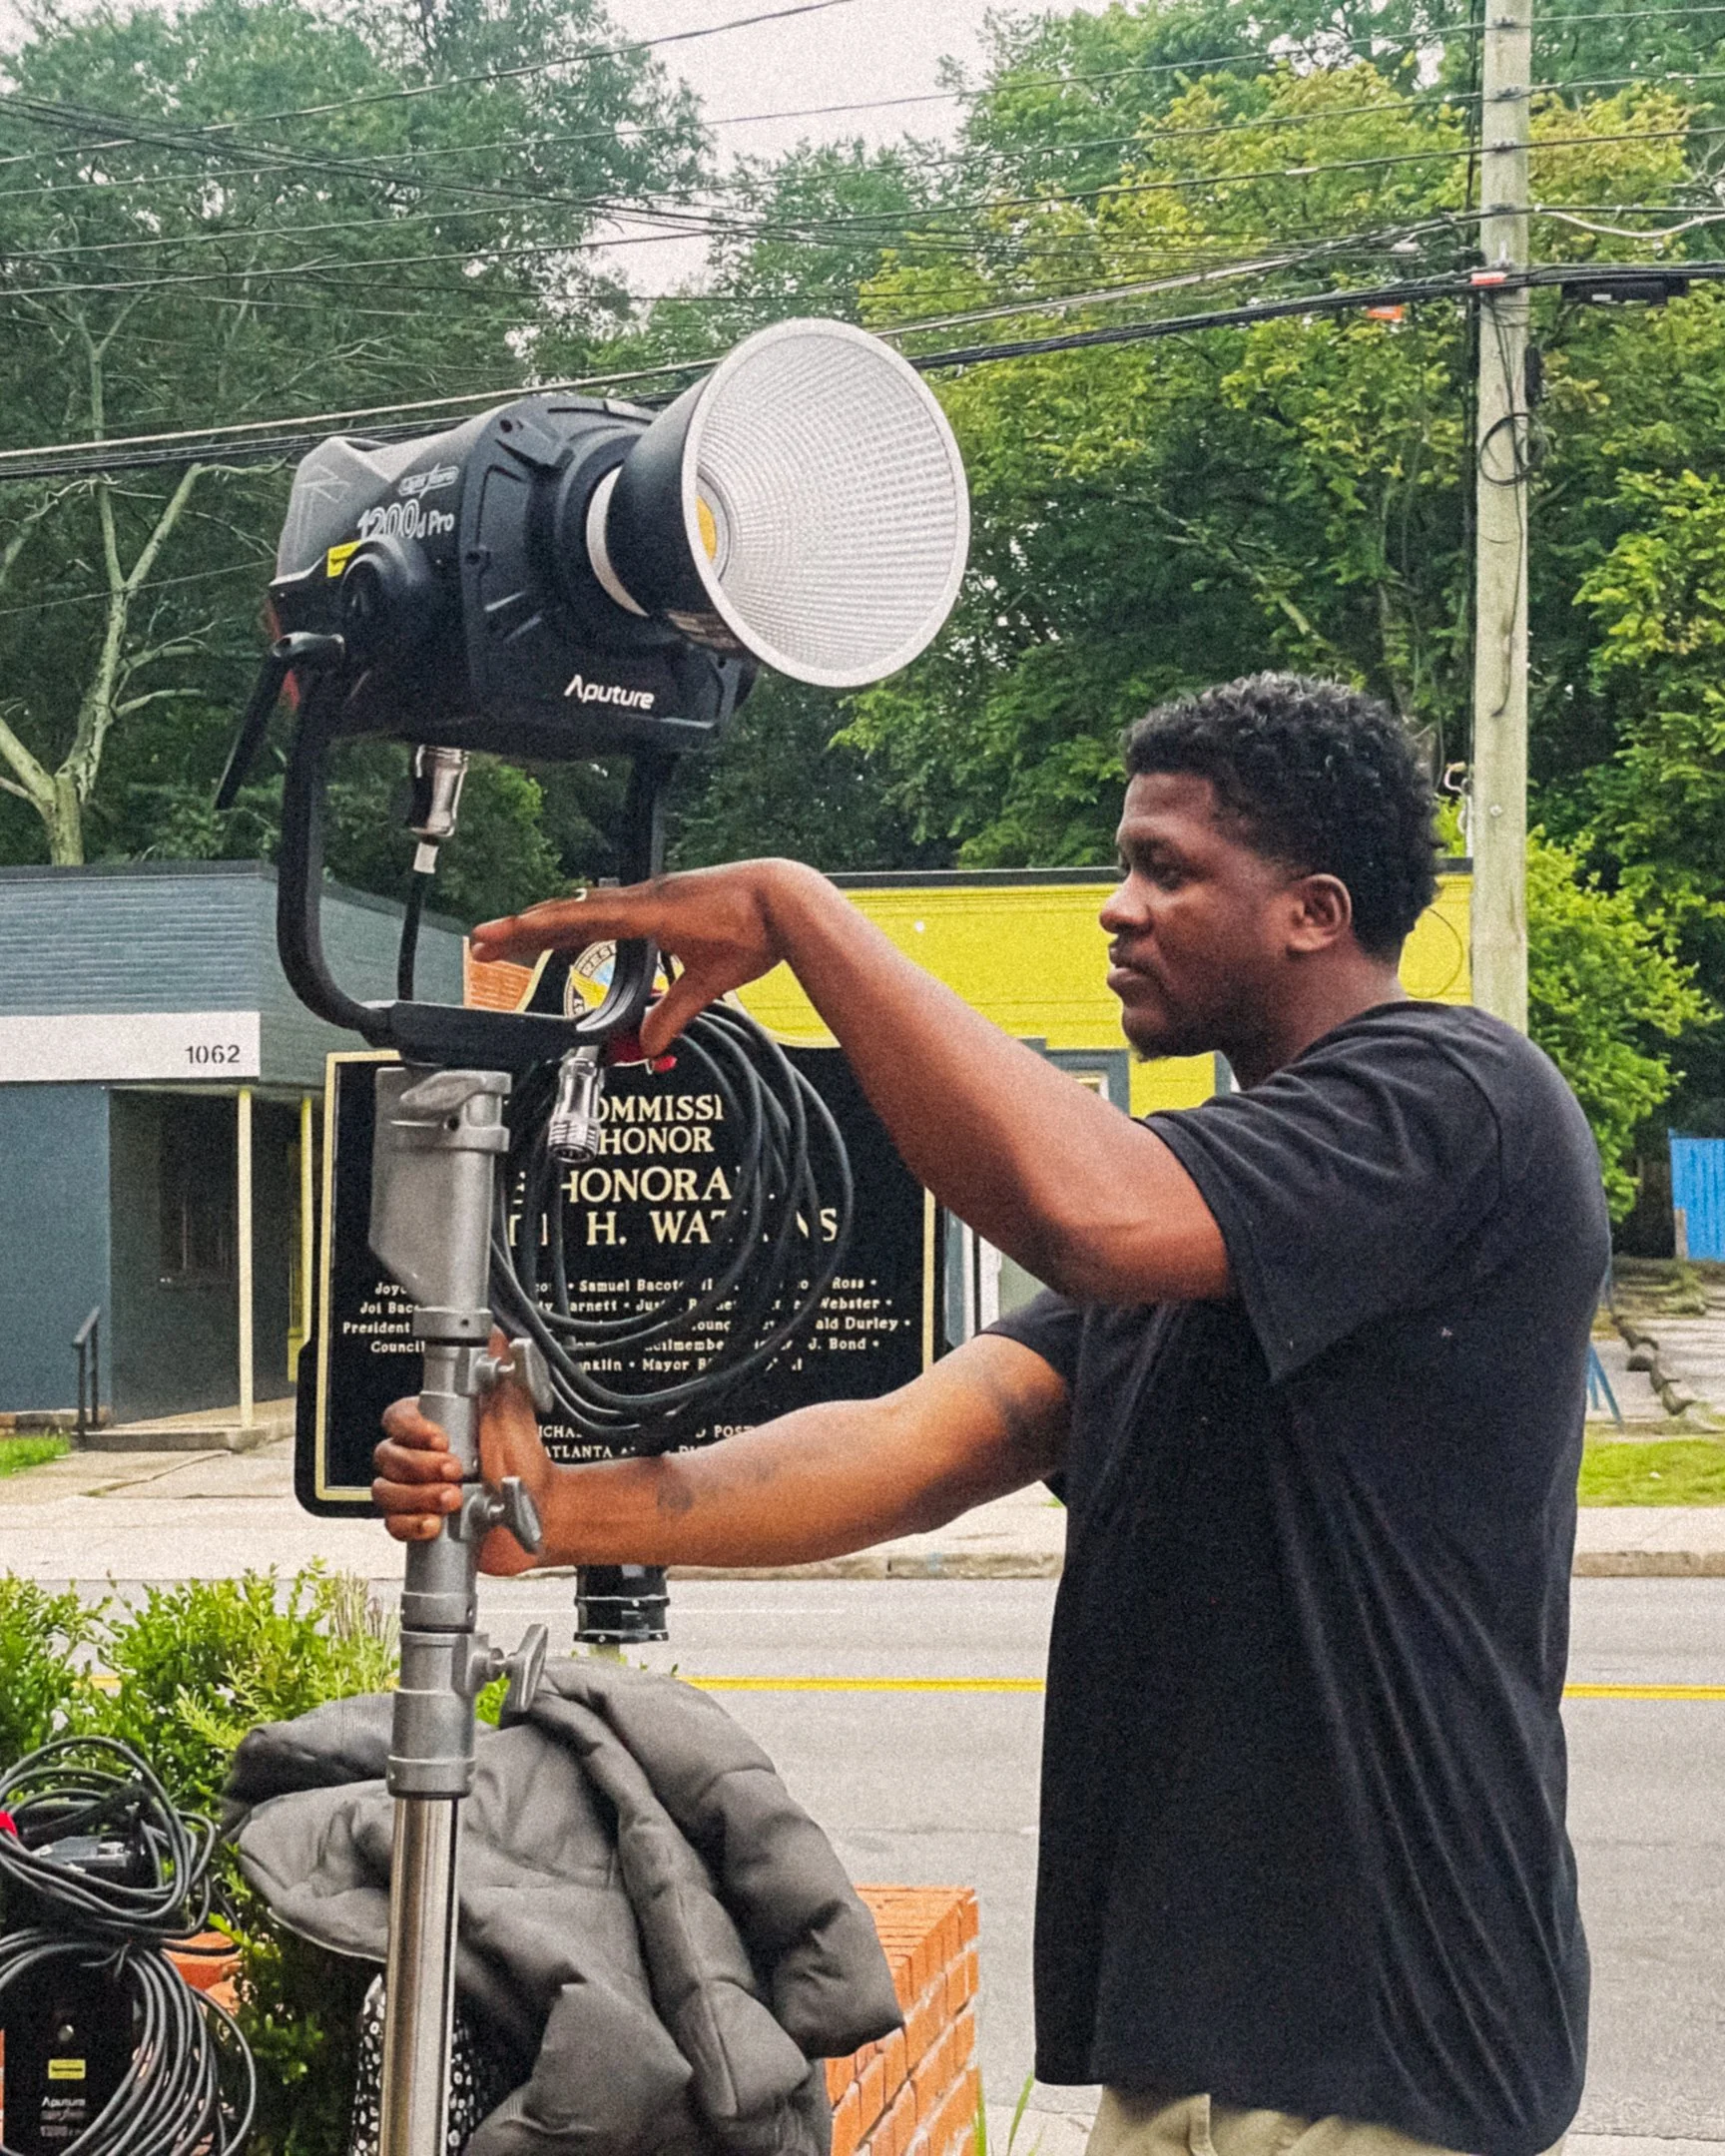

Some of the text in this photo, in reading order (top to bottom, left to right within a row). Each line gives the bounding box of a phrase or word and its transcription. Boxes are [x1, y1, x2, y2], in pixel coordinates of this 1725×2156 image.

[428, 510, 455, 536] Pro
[564, 674, 656, 710] Aputure
[185, 1044, 241, 1064] 1062
[599, 1126, 715, 1155] HONOR
[586, 1210, 627, 1246] H.
[579, 1279, 630, 1292] Samuel
[832, 1277, 864, 1290] Ross
[359, 1301, 382, 1315] Joi
[569, 1300, 617, 1313] arnett
[820, 1297, 880, 1310] Webster
[342, 1321, 410, 1335] President
[845, 1317, 898, 1332] Durley
[808, 1337, 822, 1350] J.
[829, 1337, 866, 1350] Bond
[642, 1357, 690, 1371] Mayor
